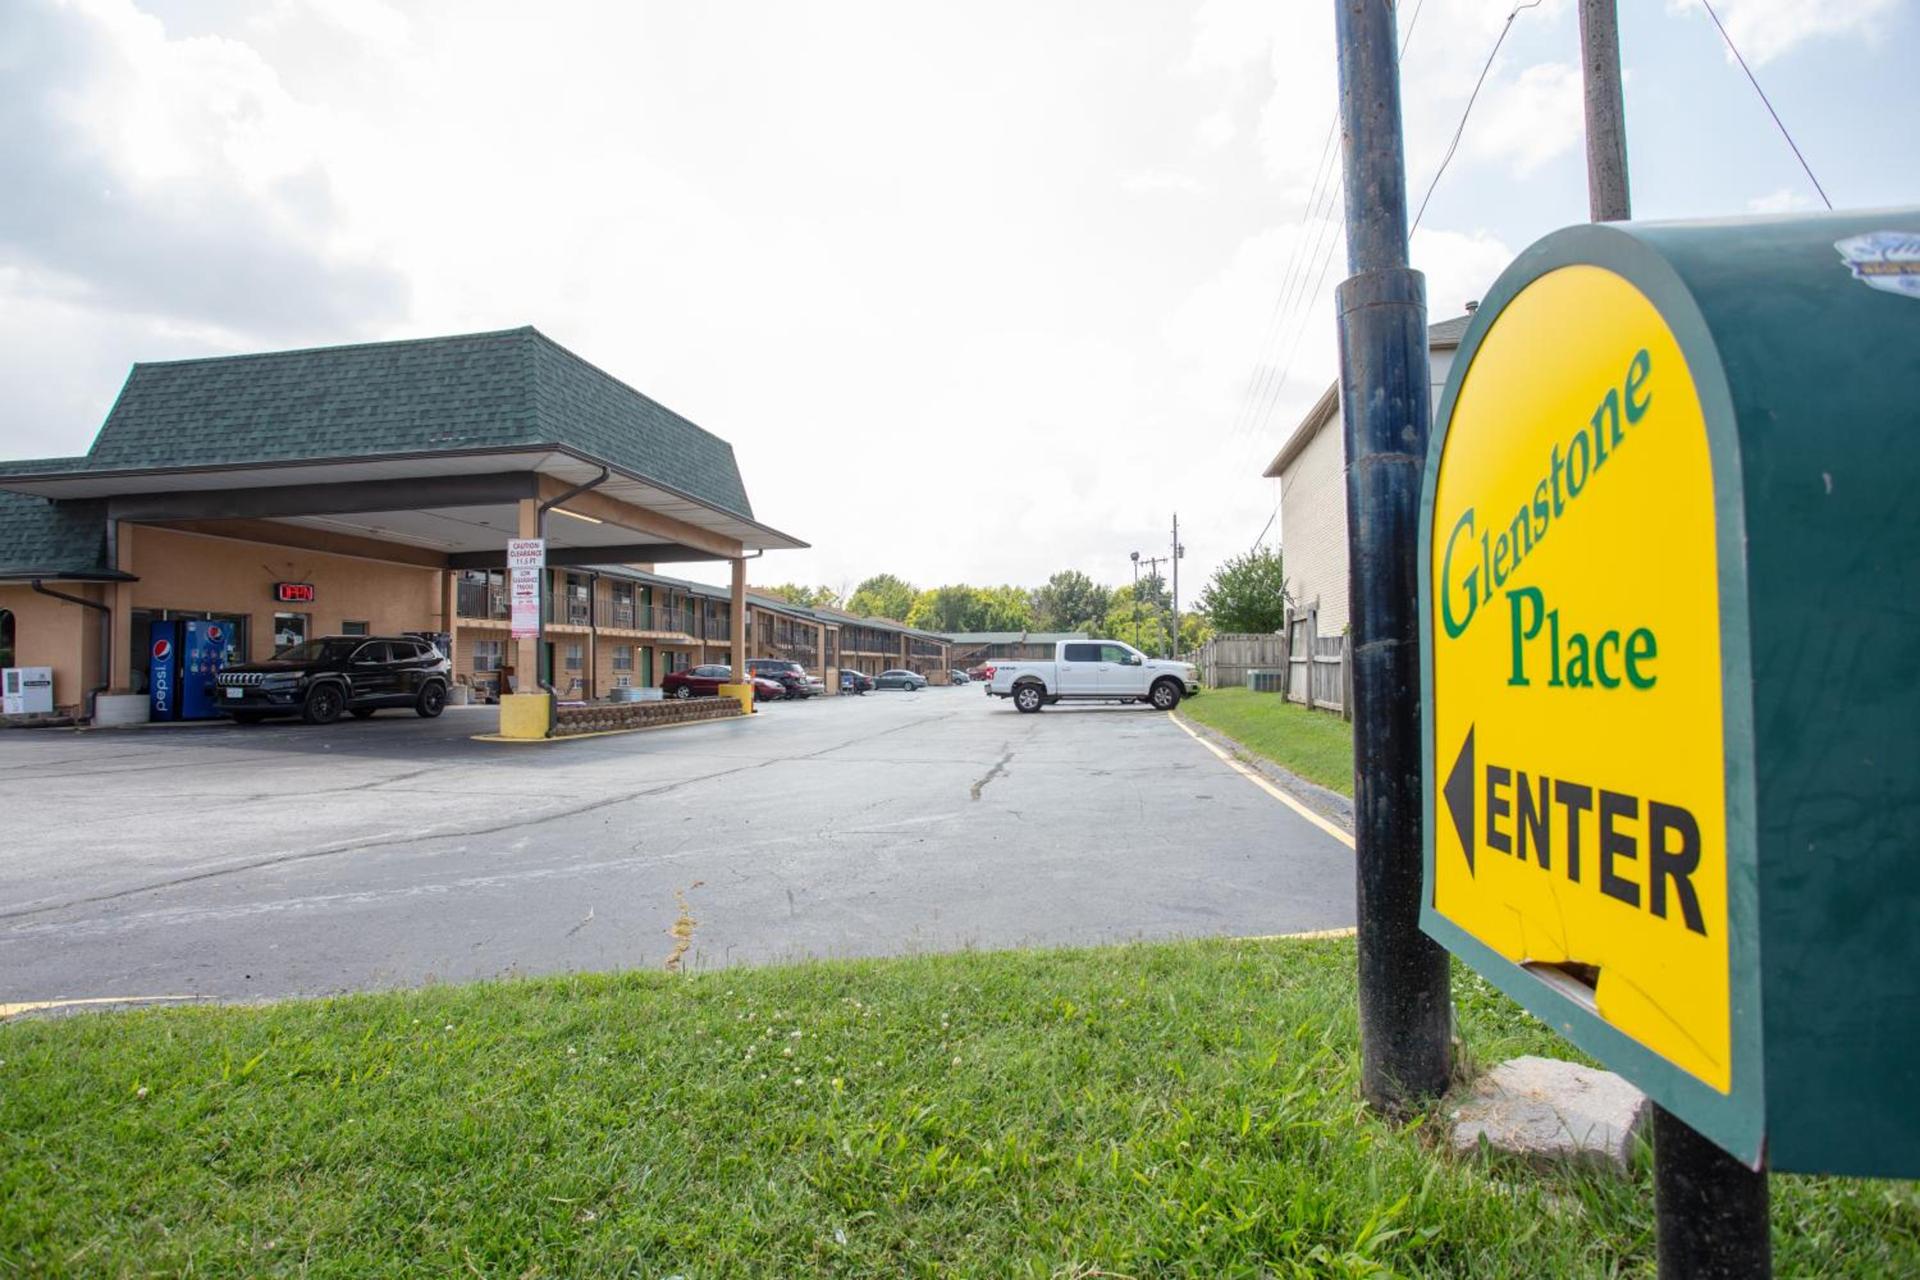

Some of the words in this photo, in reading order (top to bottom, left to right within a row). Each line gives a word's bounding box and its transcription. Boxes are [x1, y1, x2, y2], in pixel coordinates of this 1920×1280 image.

[1441, 348, 1652, 640] Glenstone
[281, 584, 312, 600] OPEN
[1505, 585, 1658, 690] Place
[154, 664, 169, 712] pepsi
[1486, 763, 1708, 938] ENTER
